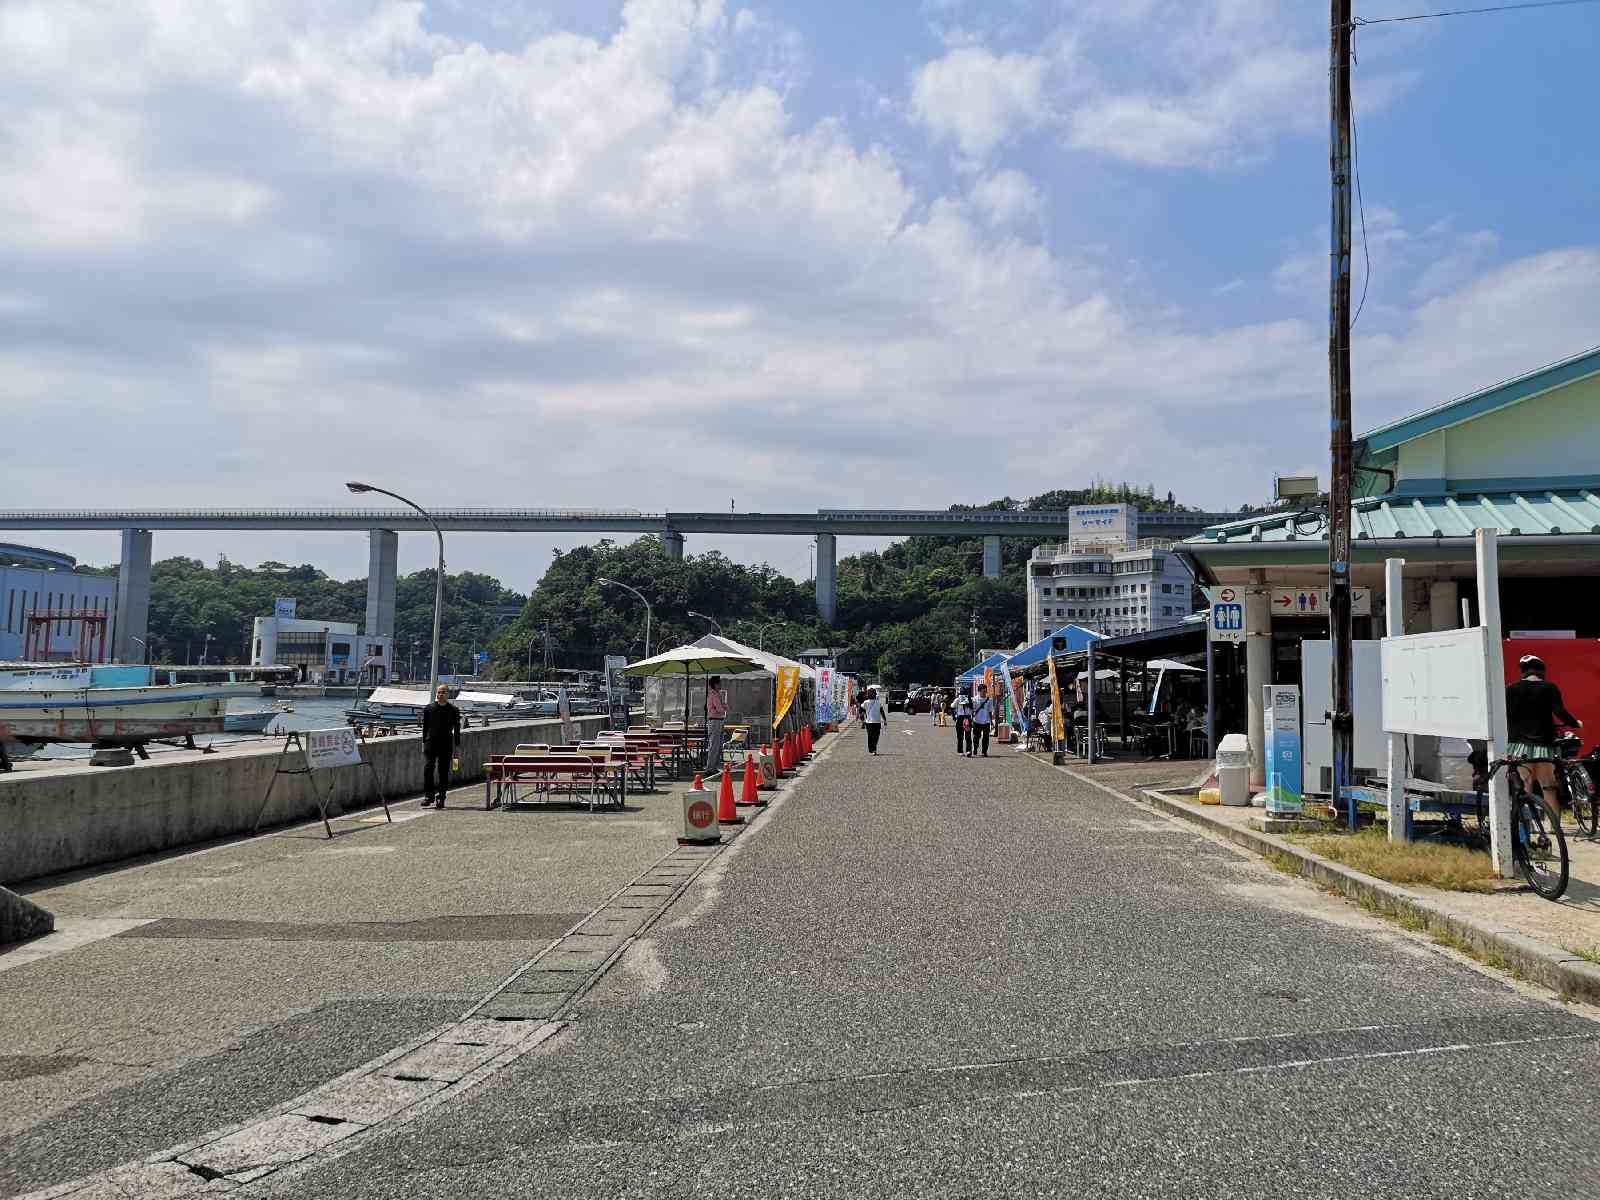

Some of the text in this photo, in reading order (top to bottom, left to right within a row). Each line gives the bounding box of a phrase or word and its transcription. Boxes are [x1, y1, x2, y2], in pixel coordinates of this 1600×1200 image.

[1325, 590, 1363, 602] トレ
[1219, 632, 1240, 640] トイレ
